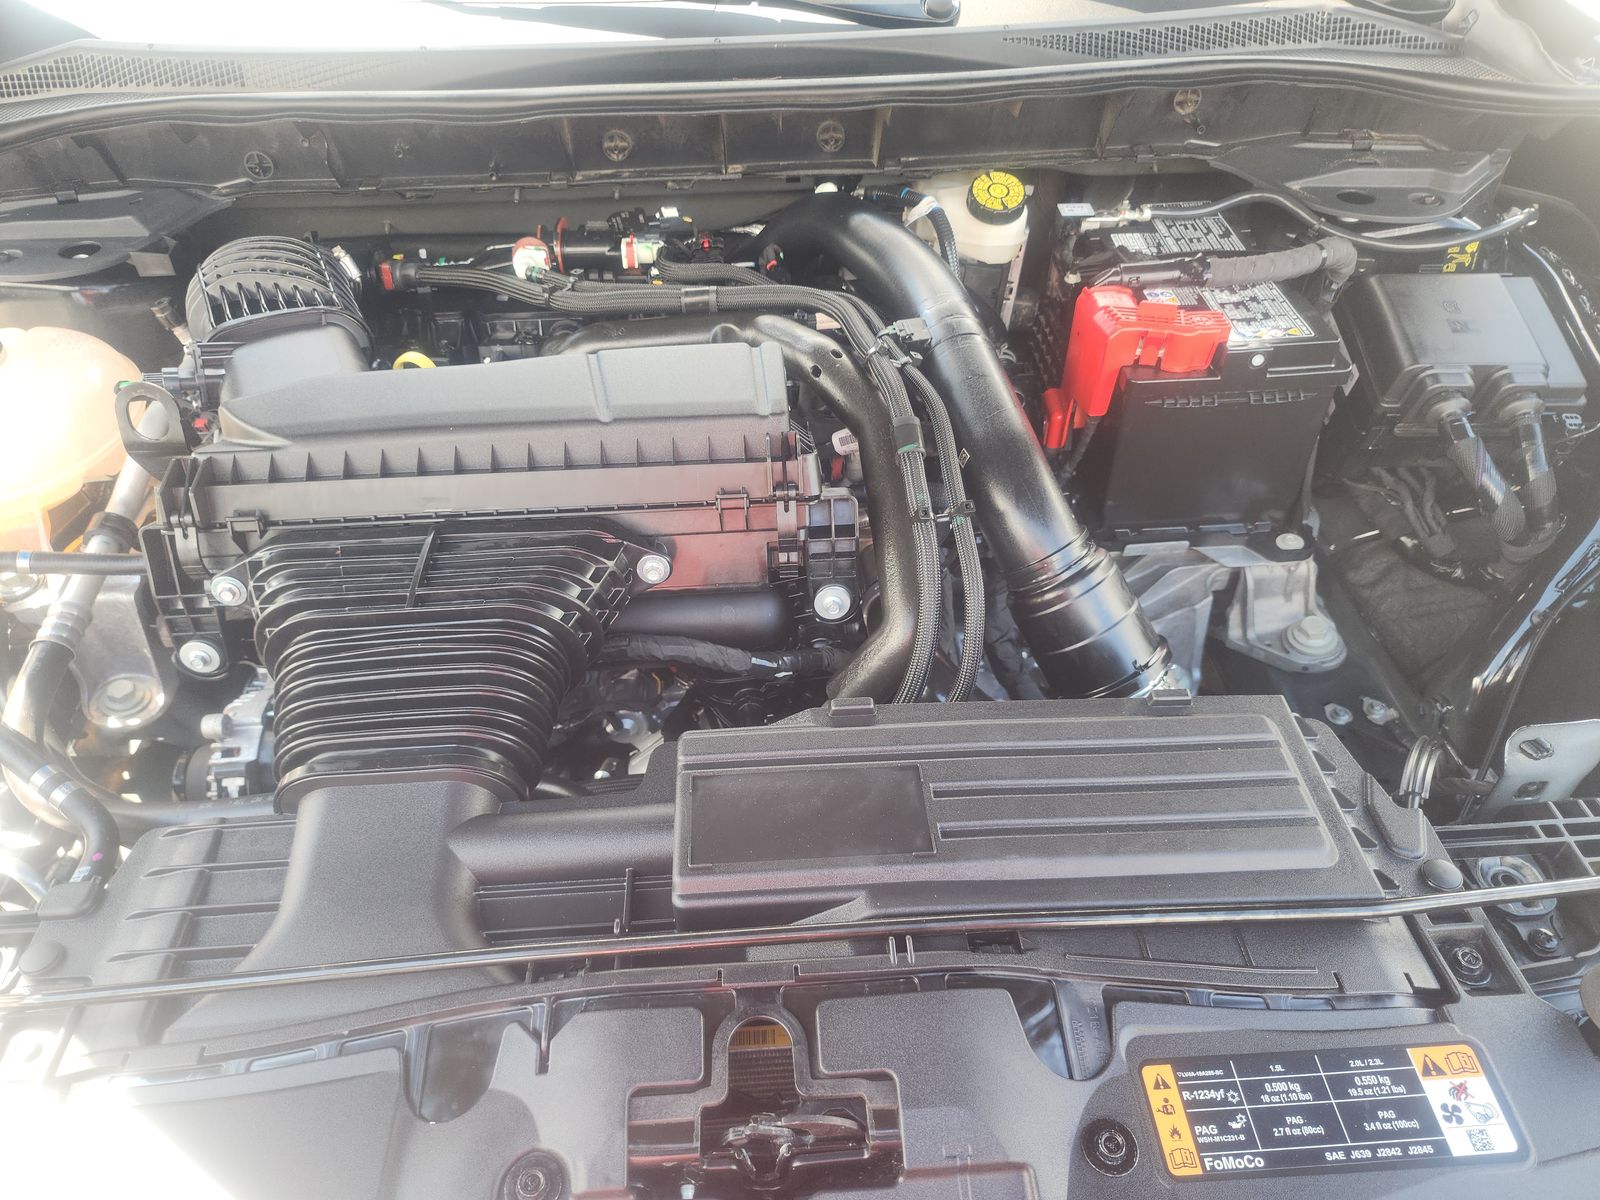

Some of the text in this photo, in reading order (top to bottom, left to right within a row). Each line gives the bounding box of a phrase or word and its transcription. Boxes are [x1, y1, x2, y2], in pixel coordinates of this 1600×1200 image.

[1349, 1059, 1365, 1067] 2.0L
[1368, 1058, 1384, 1066] 2.3L
[1354, 1075, 1391, 1086] 0.550 kg
[1264, 1081, 1301, 1092] 0.500 kg
[1348, 1088, 1364, 1097] 19.5
[1373, 1086, 1390, 1096] (1.21
[1391, 1085, 1407, 1094] lbs)
[1182, 1089, 1226, 1101] R-1234yf
[1261, 1094, 1270, 1103] 18
[1280, 1093, 1298, 1103] (1.10
[1298, 1092, 1313, 1102] lbs)
[1377, 1110, 1396, 1119] PAG
[1285, 1116, 1304, 1125] PAG
[1363, 1119, 1420, 1131] 3.4 fl oz (100cc)
[1194, 1125, 1218, 1135] PAG
[1272, 1128, 1284, 1137] 2.7
[1284, 1127, 1291, 1136] fl
[1302, 1125, 1325, 1136] (80cc)
[1325, 1145, 1434, 1161] SAE J639 J2842 J2845
[1203, 1155, 1264, 1170] FoMoCo
